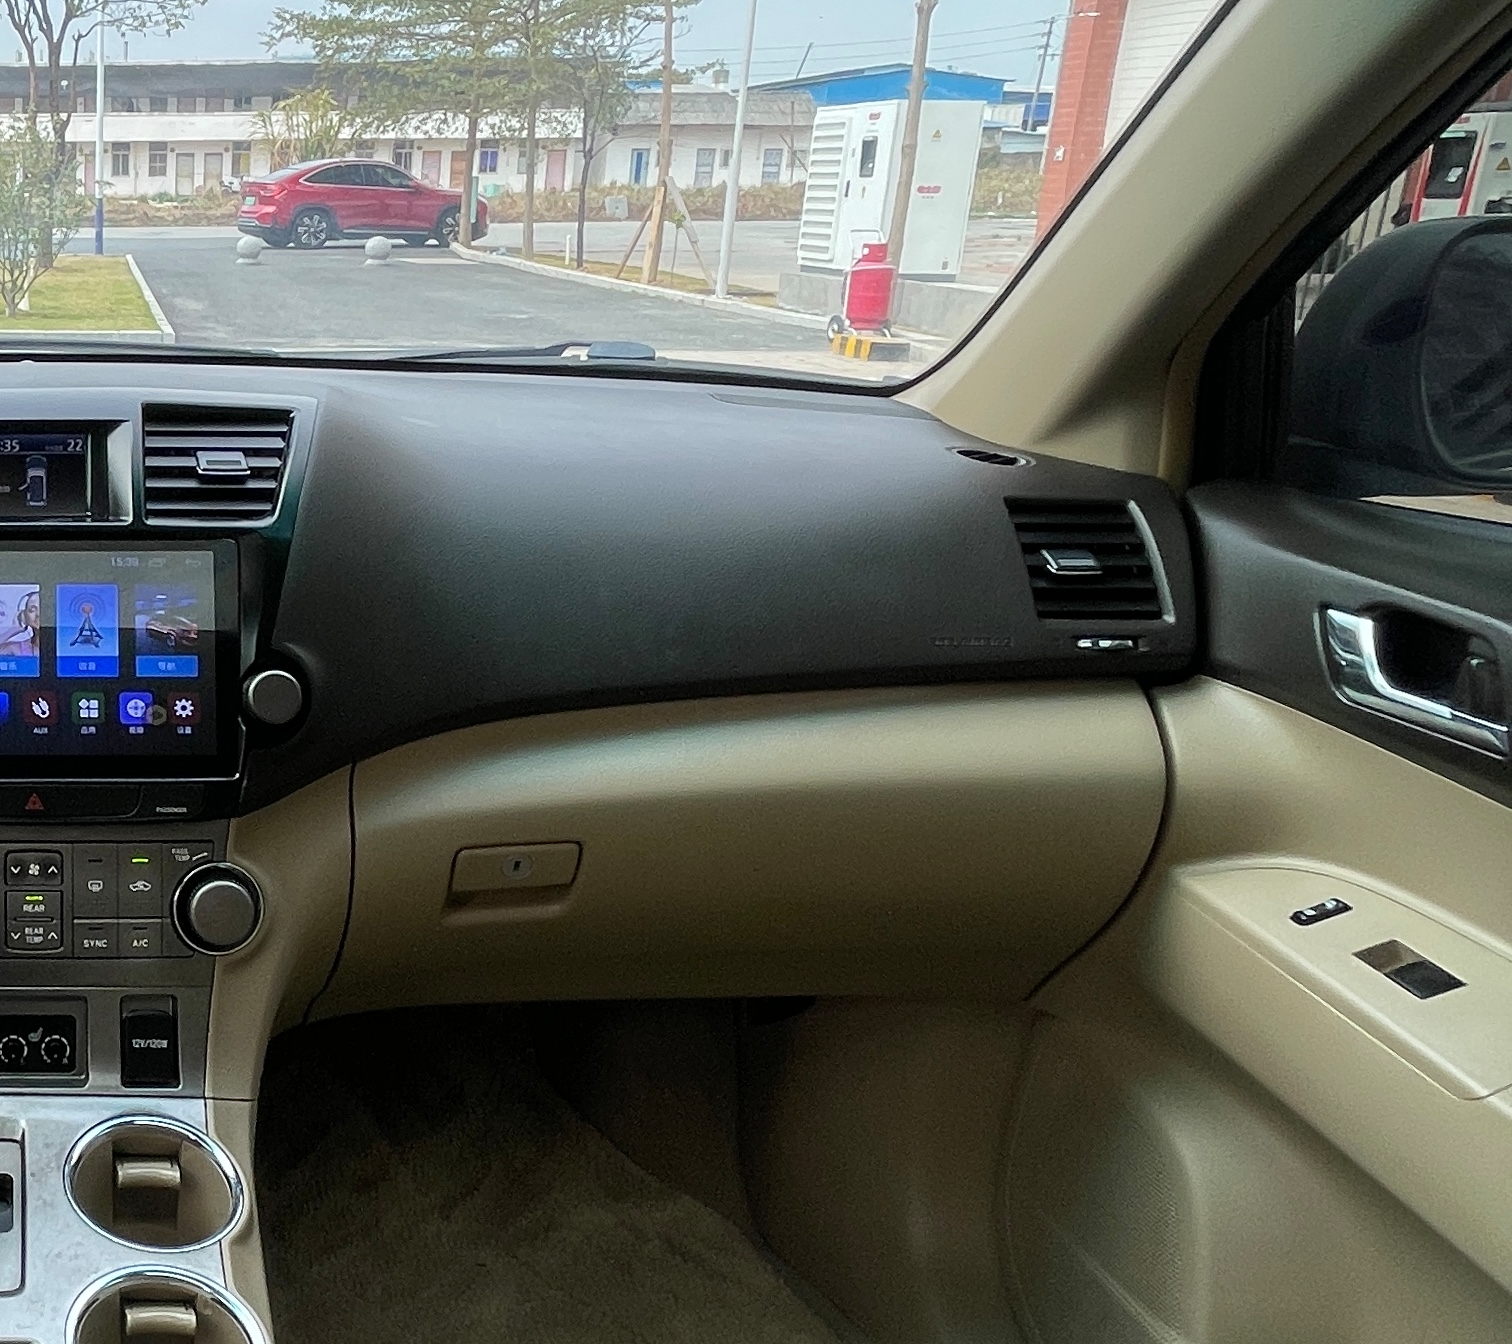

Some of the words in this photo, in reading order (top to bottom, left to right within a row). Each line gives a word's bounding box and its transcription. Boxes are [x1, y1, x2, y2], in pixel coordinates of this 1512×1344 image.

[23, 904, 45, 912] REAR
[24, 927, 44, 935] REAR
[83, 939, 108, 948] SYNC
[132, 939, 149, 948] A/C
